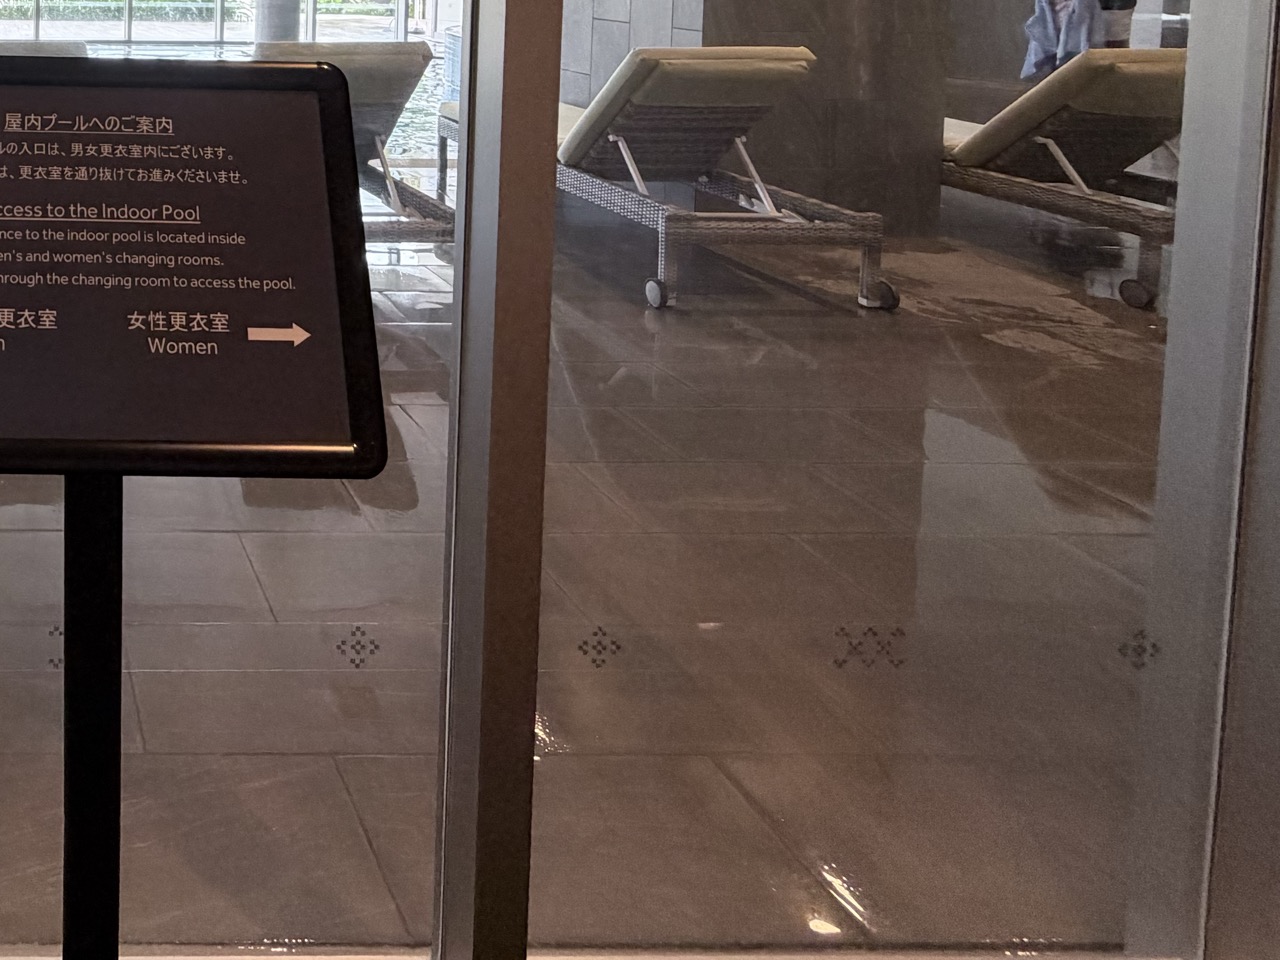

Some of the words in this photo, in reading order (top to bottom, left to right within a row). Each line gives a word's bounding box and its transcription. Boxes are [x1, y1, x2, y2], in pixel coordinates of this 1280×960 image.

[2, 112, 176, 135] 屋内プールへのご案内
[45, 202, 66, 218] to
[68, 202, 99, 219] the
[101, 202, 159, 220] Indoor
[161, 204, 201, 221] Pool
[24, 228, 41, 241] to
[41, 227, 66, 241] the
[66, 228, 111, 242] indoor
[111, 229, 142, 245] pool
[143, 230, 155, 243] is
[155, 230, 206, 244] located
[207, 231, 247, 246] inside
[24, 249, 51, 263] and
[51, 250, 114, 264] women's
[114, 251, 176, 269] changing
[177, 255, 225, 267] rooms.
[45, 271, 70, 286] the
[70, 272, 133, 290] changing
[134, 276, 171, 288] room
[172, 275, 189, 288] to
[189, 277, 237, 289] access
[237, 276, 262, 290] the
[262, 276, 297, 293] pool.
[126, 309, 231, 333] 女性更衣室
[147, 336, 219, 356] Women
